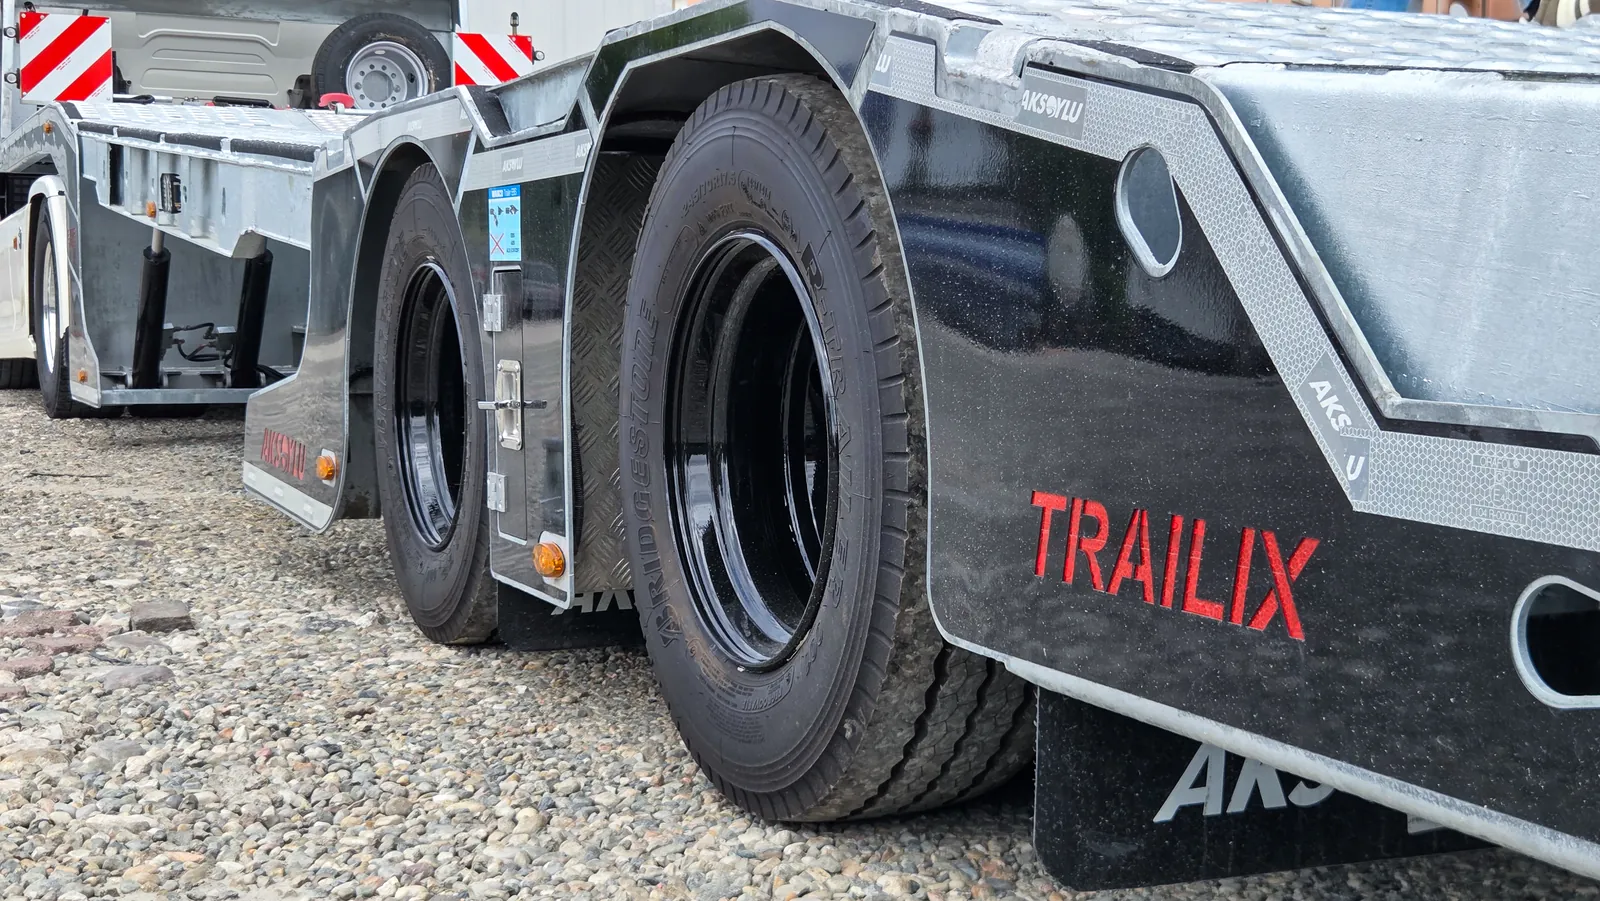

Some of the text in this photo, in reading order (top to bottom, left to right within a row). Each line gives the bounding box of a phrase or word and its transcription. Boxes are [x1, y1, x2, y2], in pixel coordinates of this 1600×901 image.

[1021, 89, 1084, 123] AKSOYLU
[629, 298, 685, 648] BRIDGESTONE
[1031, 490, 1320, 641] TRAILIX
